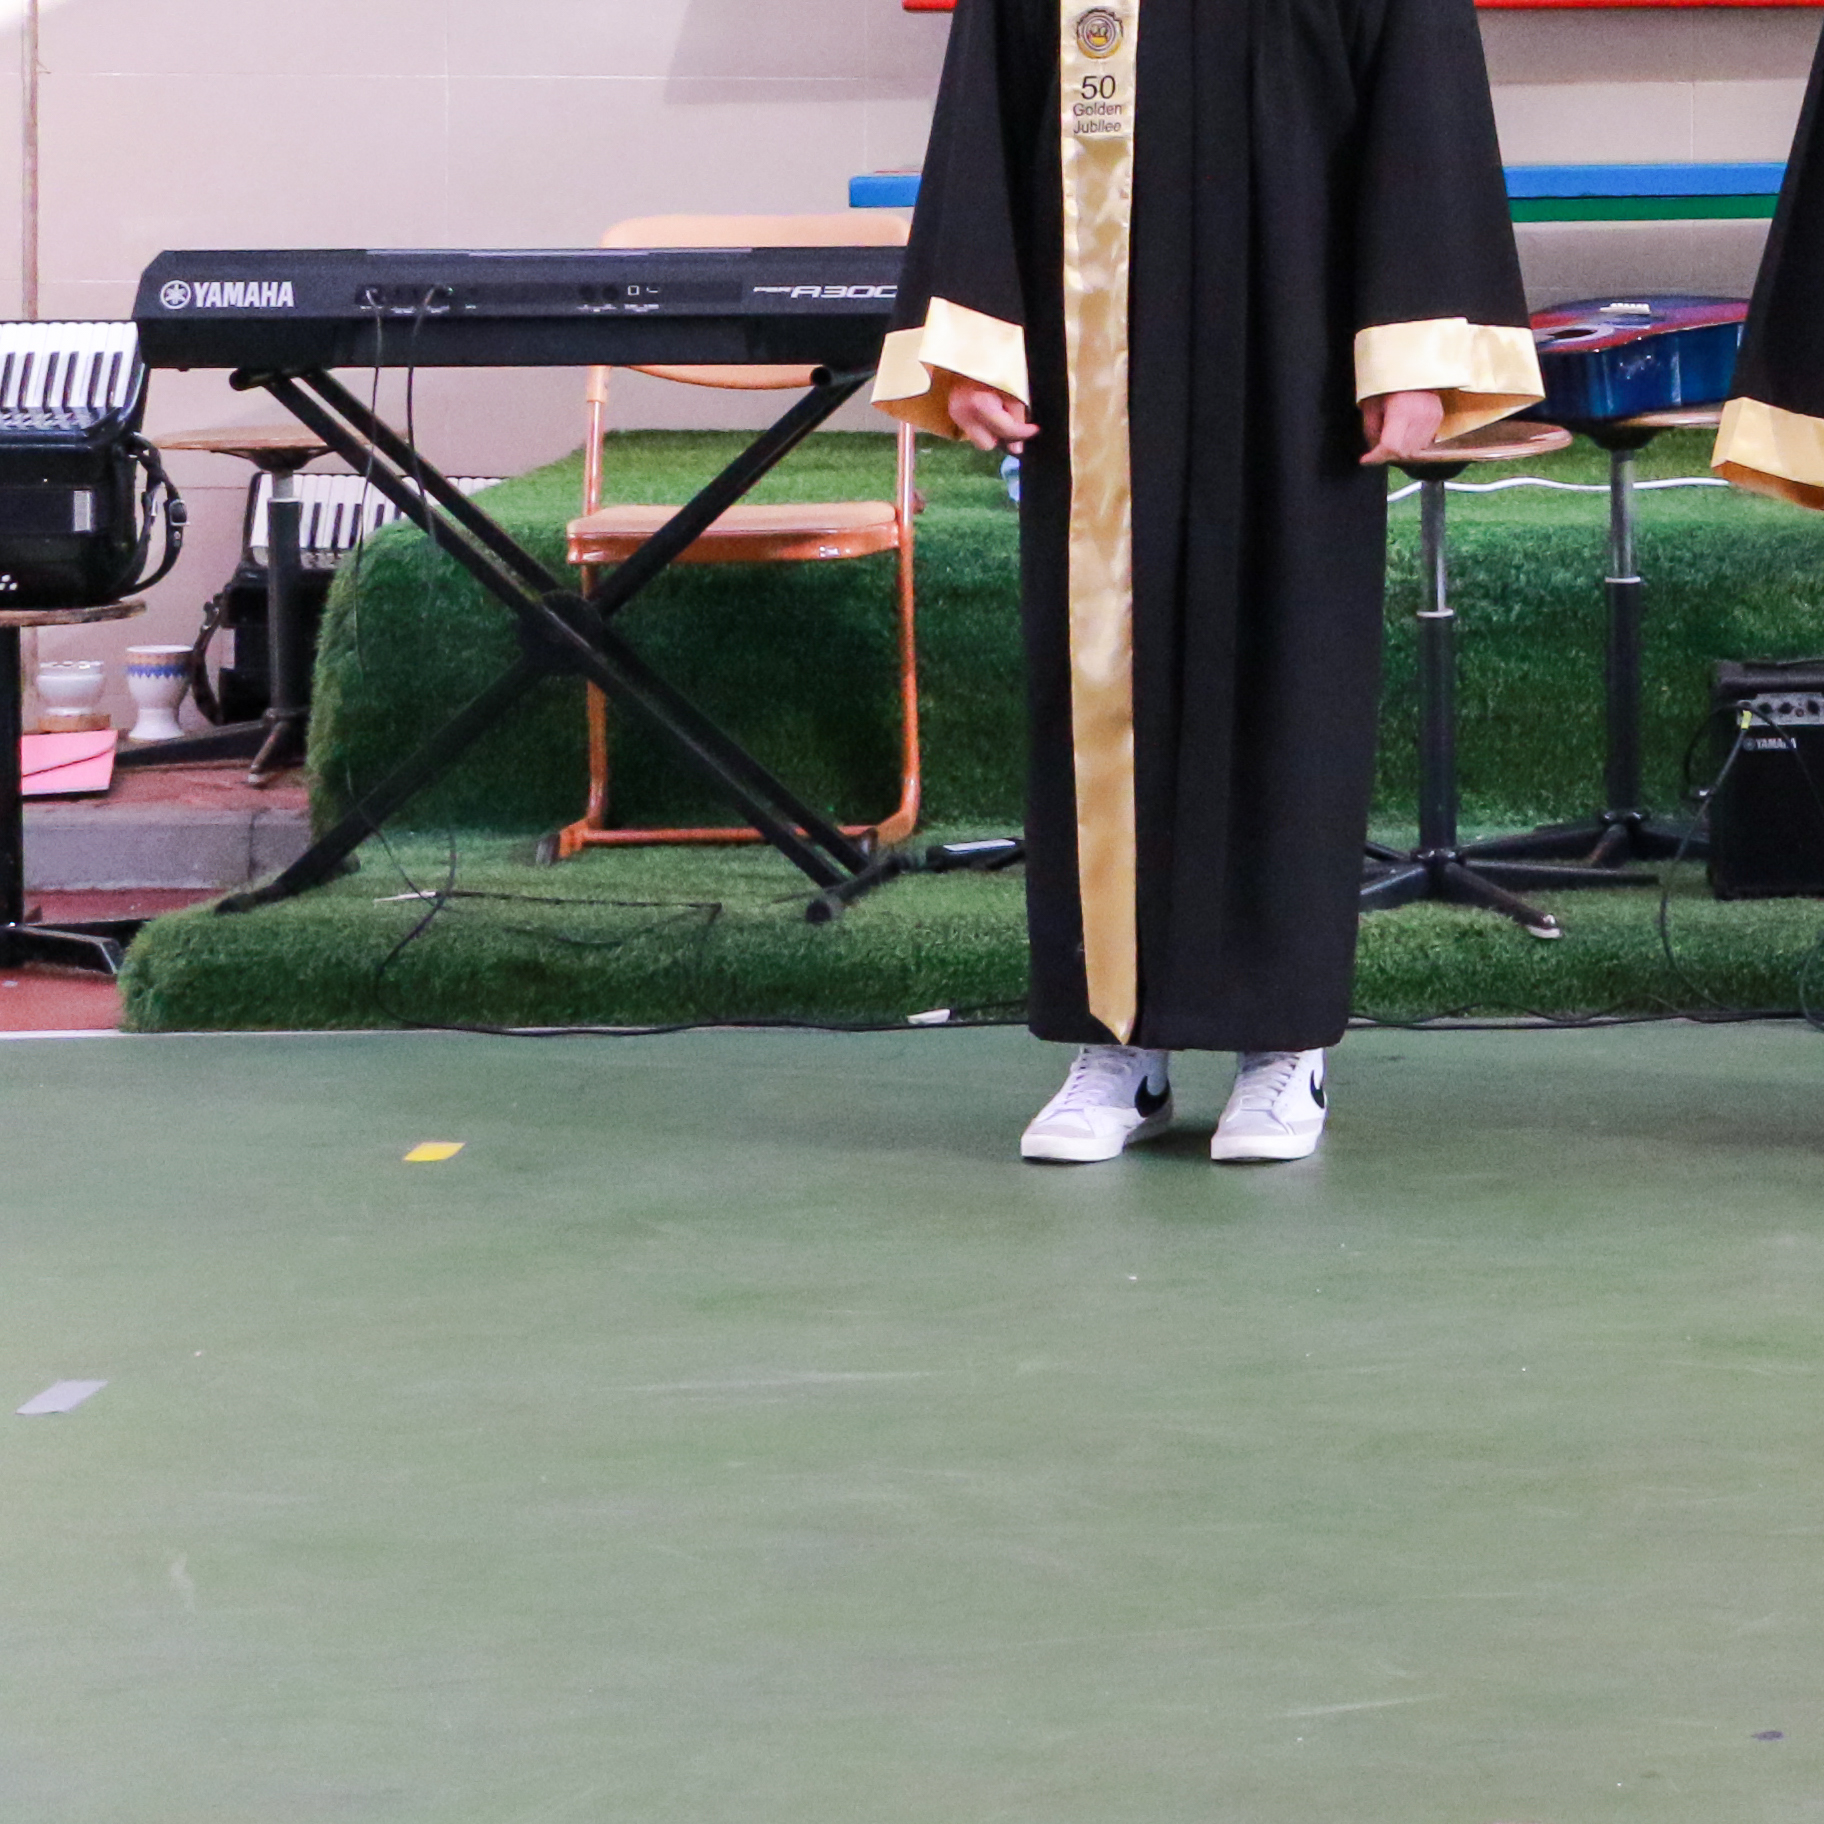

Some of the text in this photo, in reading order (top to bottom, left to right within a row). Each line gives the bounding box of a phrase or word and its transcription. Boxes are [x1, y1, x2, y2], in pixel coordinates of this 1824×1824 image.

[1080, 75, 1116, 101] 50
[1072, 102, 1123, 118] Golden
[1072, 118, 1122, 135] Jubilee
[193, 281, 295, 307] YAMAHA
